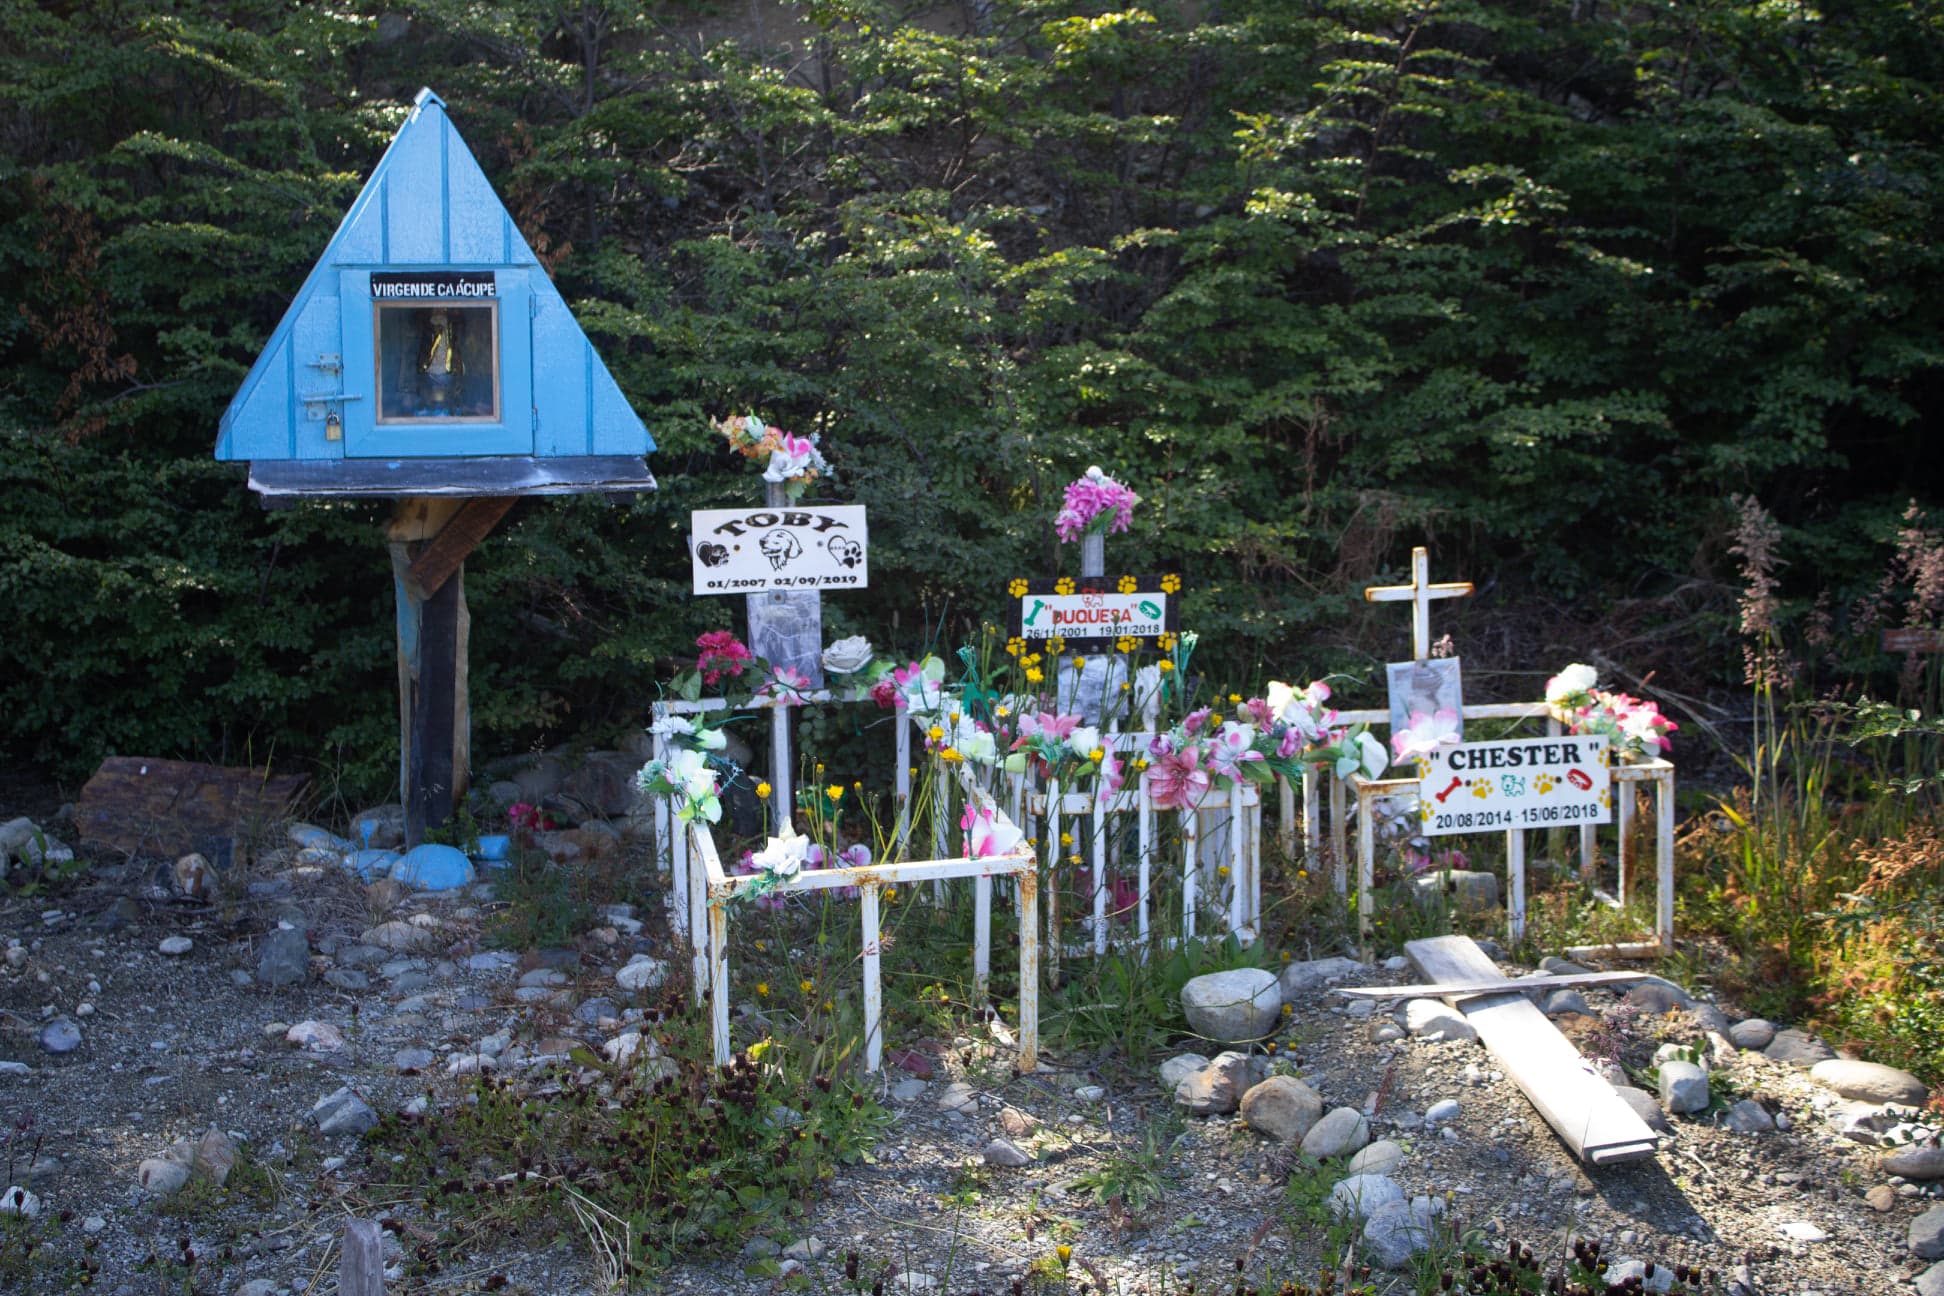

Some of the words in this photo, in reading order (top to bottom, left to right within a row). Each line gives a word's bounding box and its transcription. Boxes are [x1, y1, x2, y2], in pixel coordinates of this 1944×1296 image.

[713, 511, 849, 537] TOBY
[707, 579, 767, 589] 01/2007
[774, 575, 857, 587] 02/09/2019
[1447, 743, 1582, 770] CHESTER
[1435, 810, 1512, 829] 20/08/2014
[1521, 803, 1598, 823] 15/06/2018
